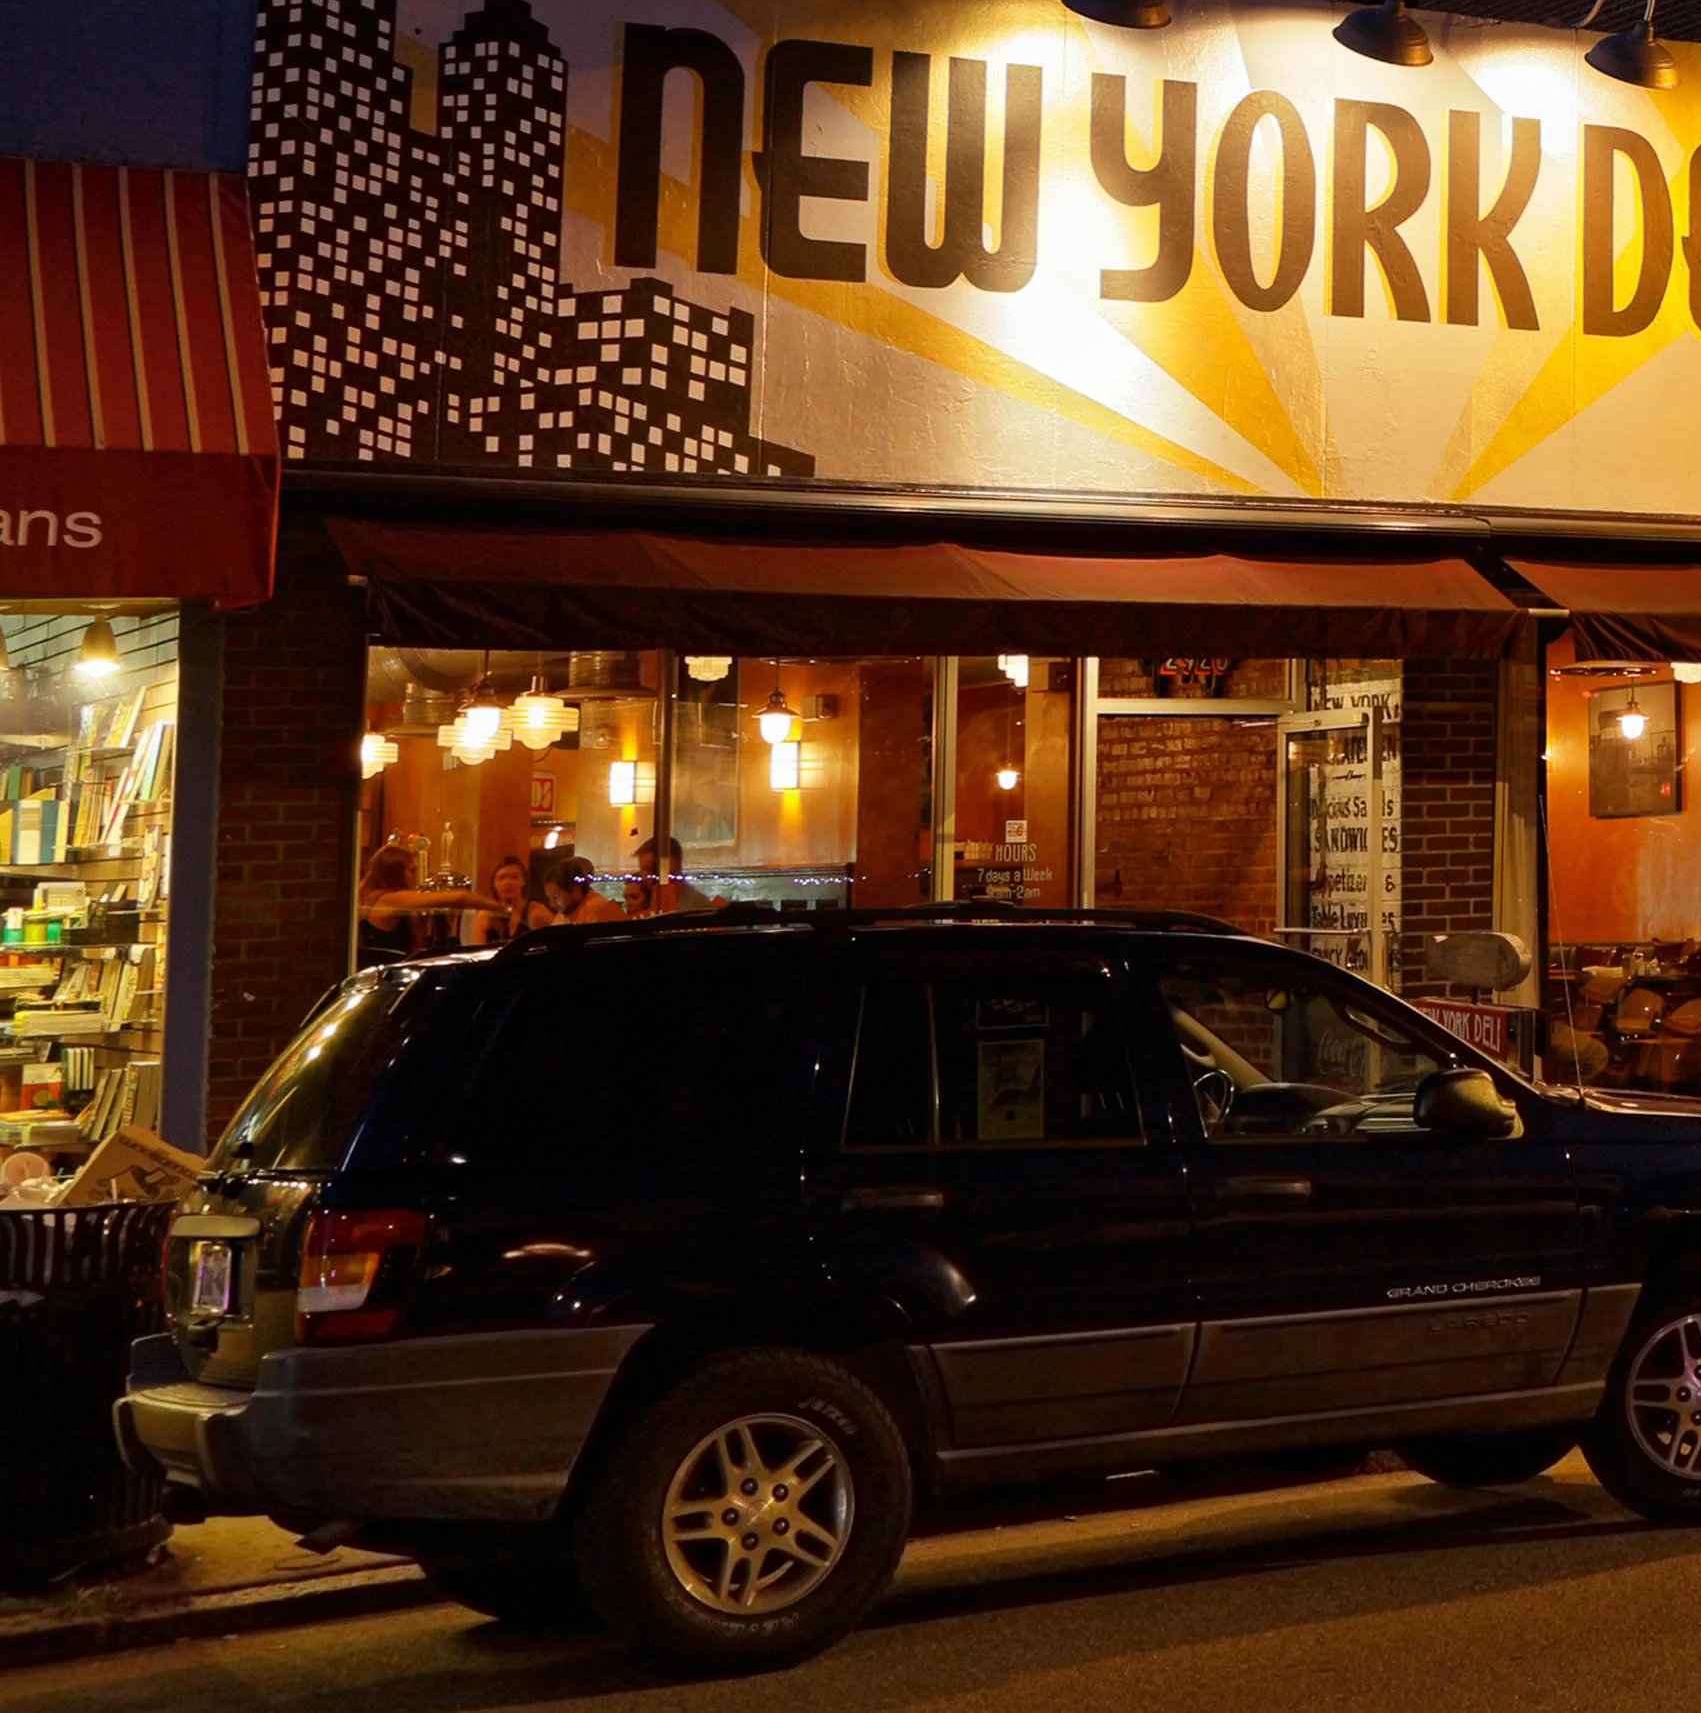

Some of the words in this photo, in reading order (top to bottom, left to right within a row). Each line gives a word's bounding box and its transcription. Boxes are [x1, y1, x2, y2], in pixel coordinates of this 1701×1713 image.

[614, 21, 1042, 294] NEW
[1089, 72, 1542, 332] YORK
[995, 843, 1037, 863] HOURS
[1442, 1009, 1470, 1041] YORK
[1474, 1013, 1501, 1054] DELI
[1386, 1285, 1448, 1299] GRAND
[1451, 1276, 1542, 1294] CHEROKEE
